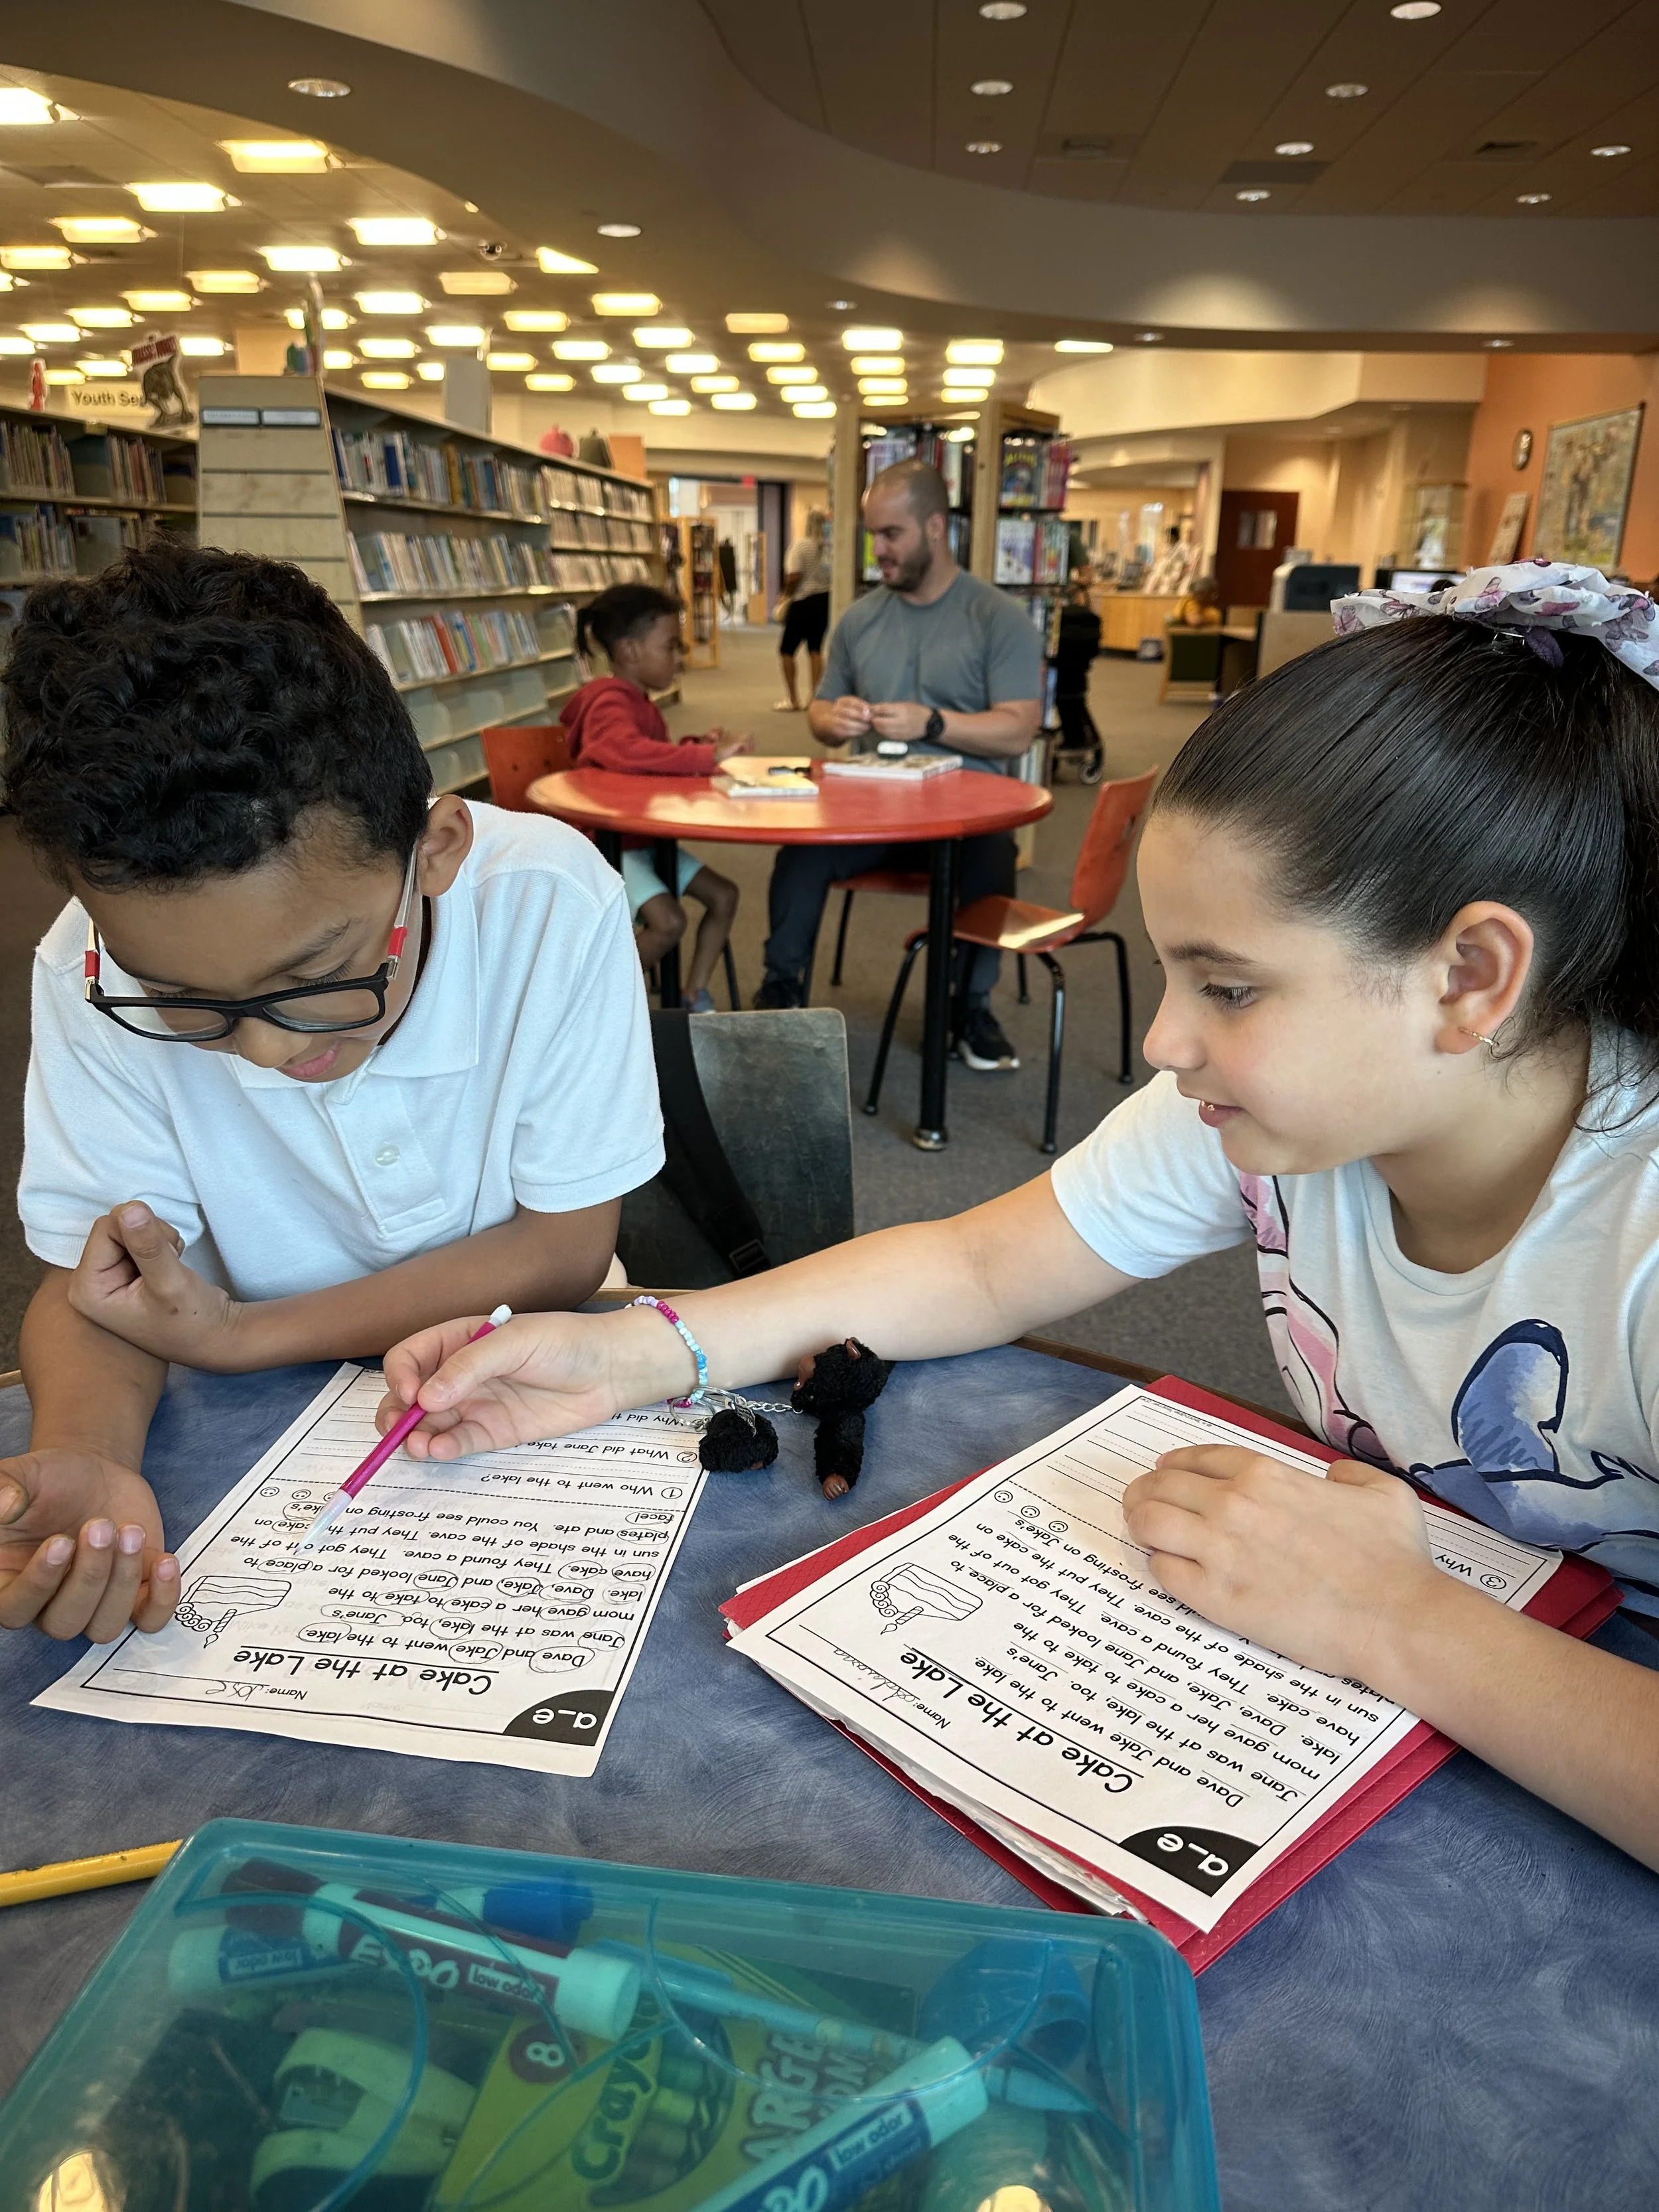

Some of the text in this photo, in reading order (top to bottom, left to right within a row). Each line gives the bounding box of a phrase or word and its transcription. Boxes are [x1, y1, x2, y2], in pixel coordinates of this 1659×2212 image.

[72, 391, 115, 407] Youth
[564, 1444, 599, 1453] Jane
[630, 1448, 668, 1459] What
[481, 1474, 521, 1484] lake?
[527, 1477, 550, 1486] the
[620, 1485, 652, 1495] Who
[368, 1507, 430, 1521] frosting
[466, 1516, 508, 1526] could
[635, 1513, 674, 1524] face!
[350, 1526, 379, 1536] put
[382, 1527, 418, 1540] They
[514, 1521, 538, 1532] You
[553, 1525, 580, 1534] ate.
[977, 1524, 993, 1534] on
[472, 1536, 496, 1546] the
[618, 1528, 668, 1543] plates
[502, 1540, 523, 1548] of
[530, 1542, 575, 1554] shade
[997, 1535, 1028, 1552] cake
[231, 1536, 652, 1582] have cake. They found cave. They got of the
[581, 1546, 607, 1557] the
[1015, 1519, 1177, 1603] see frosting on Jake's
[1032, 1554, 1055, 1569] the
[1435, 1554, 1471, 1576] Why
[244, 1558, 642, 1601] lake. Dave, Jake, and Jane looked for place to
[1058, 1570, 1089, 1584] put
[1088, 1584, 1124, 1608] They
[328, 1588, 634, 1620] mom gave her cake to take to the
[332, 1610, 387, 1624] Jane's
[395, 1615, 429, 1628] too.
[1135, 1605, 1171, 1625] cave.
[439, 1619, 475, 1634] lake,
[482, 1625, 508, 1636] the
[516, 1627, 535, 1637] at
[1176, 1625, 1202, 1642] the
[578, 1632, 624, 1648] Jane
[948, 1535, 1360, 1745] have cake. They found cave. They got out of the
[1204, 1642, 1228, 1652] of
[299, 1630, 585, 1668] Dave and Jake went to the lake.
[951, 1562, 1340, 1765] lake. Dave, Jake, and Jane looked for place to
[1234, 1652, 1284, 1679] shade
[234, 1651, 491, 1695] Cake at the Lake
[833, 1647, 918, 1705] Adriana
[204, 1680, 263, 1702] Jose
[265, 1685, 307, 1700] Name:
[1290, 1680, 1318, 1697] the
[1014, 1623, 1320, 1779] mom gave her cake to take to the
[913, 1703, 950, 1729] Name:
[1348, 1704, 1378, 1722] sun
[901, 1653, 1132, 1793] Cake at the Lake
[1007, 1649, 1297, 1801] Jane was at the lake, too. Jane's
[975, 1658, 1243, 1807] Dave and Jake went to the lake.
[525, 2042, 565, 2068] 8
